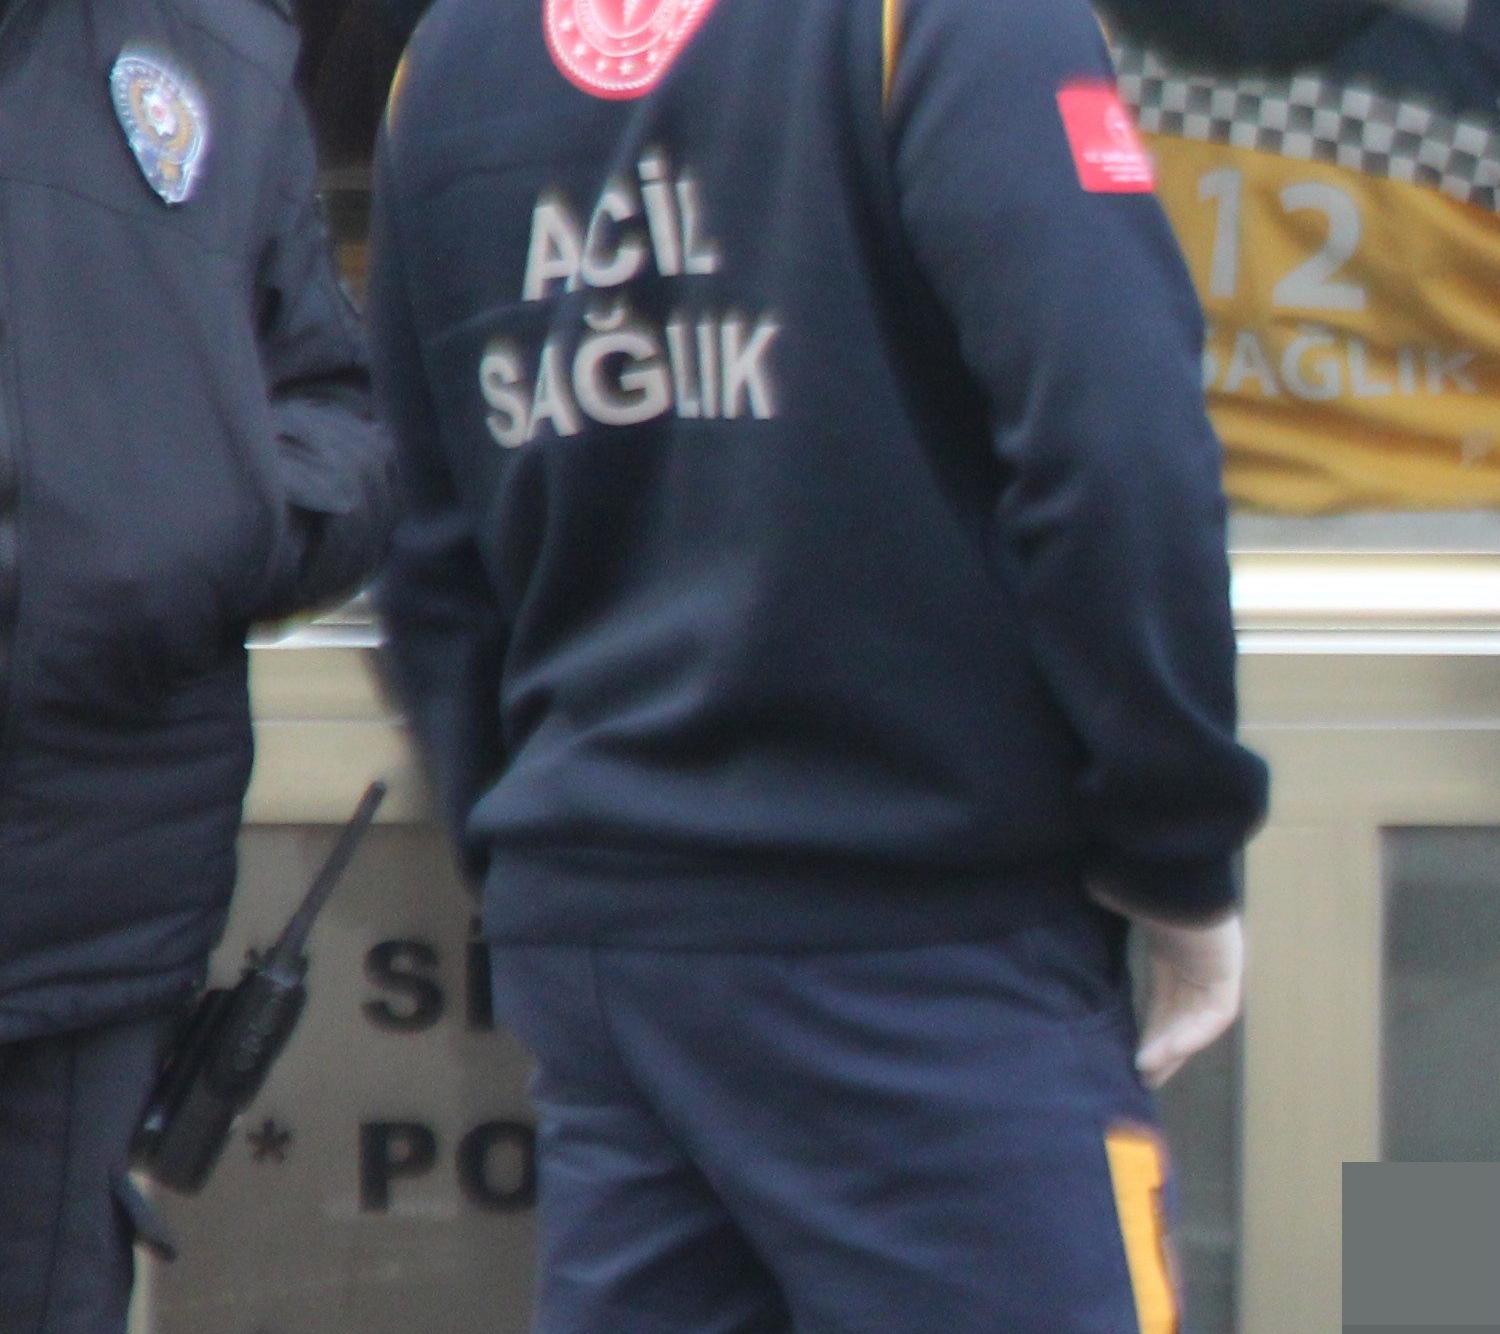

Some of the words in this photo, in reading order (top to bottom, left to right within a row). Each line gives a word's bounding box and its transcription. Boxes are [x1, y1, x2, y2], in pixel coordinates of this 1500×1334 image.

[521, 157, 718, 302] ACİL
[1197, 165, 1367, 311] 12
[479, 303, 781, 450] SAĞLIK
[361, 915, 496, 1034] Sİ
[358, 1119, 538, 1215] PO
